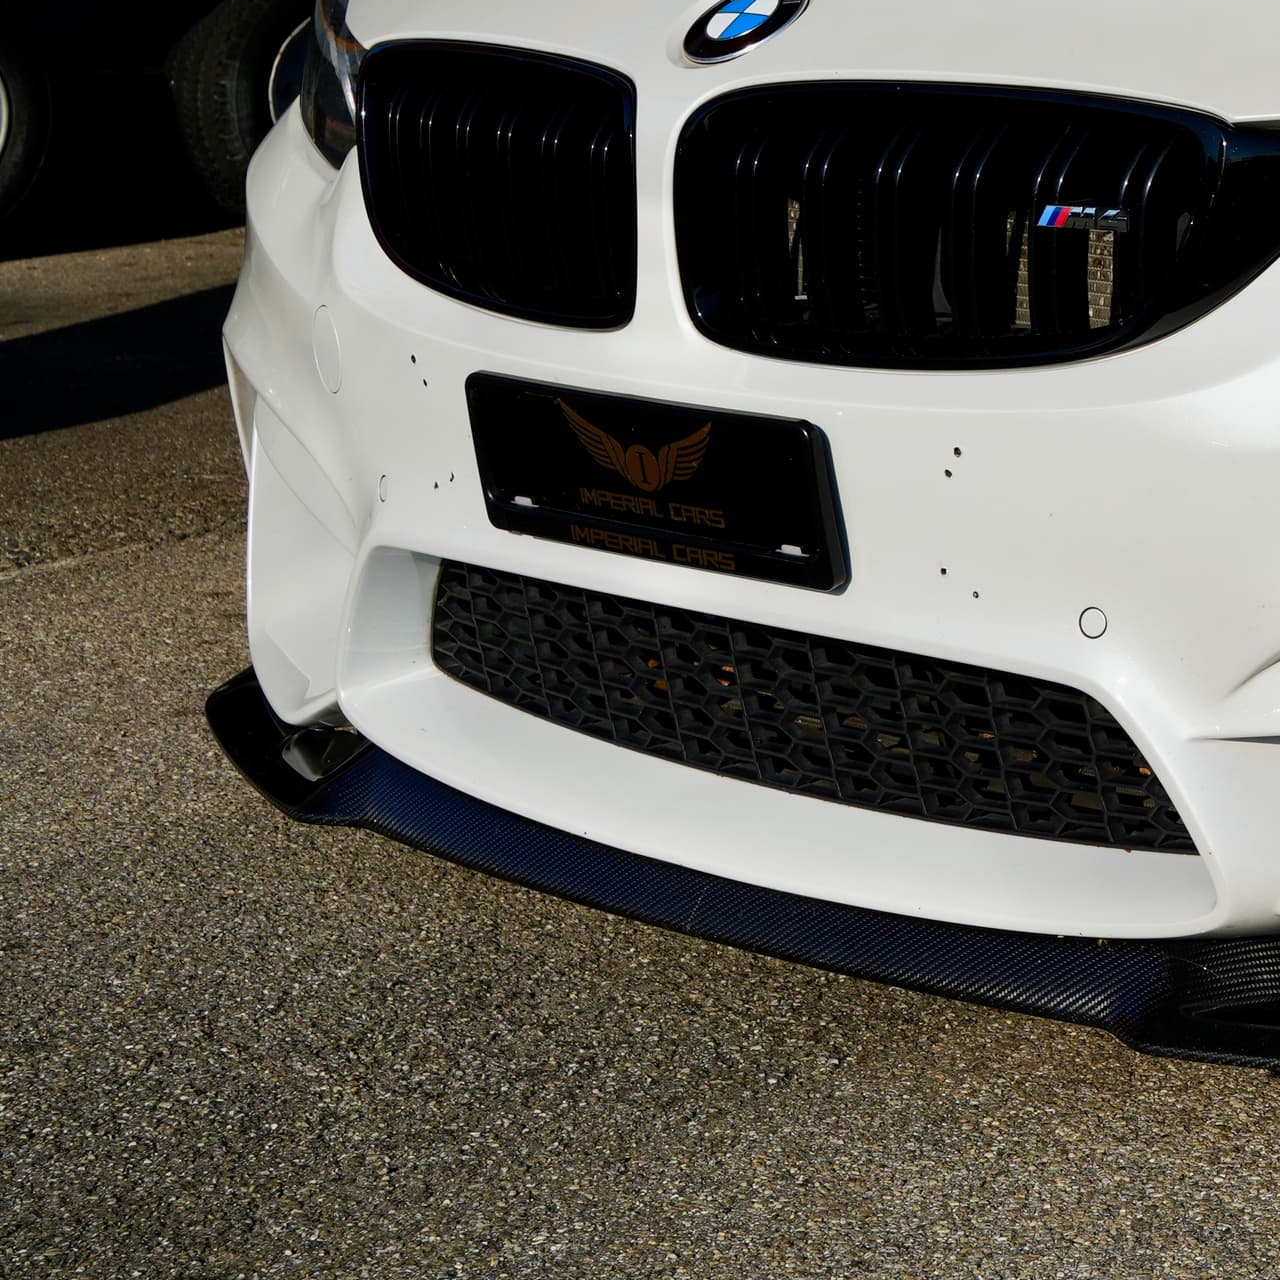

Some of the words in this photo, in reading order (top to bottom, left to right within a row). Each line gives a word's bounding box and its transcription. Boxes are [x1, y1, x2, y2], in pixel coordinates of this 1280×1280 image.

[579, 487, 665, 519] IMPERIAL
[669, 503, 727, 529] CARS
[570, 524, 666, 560] IMPERIAL
[671, 543, 737, 571] CARS
